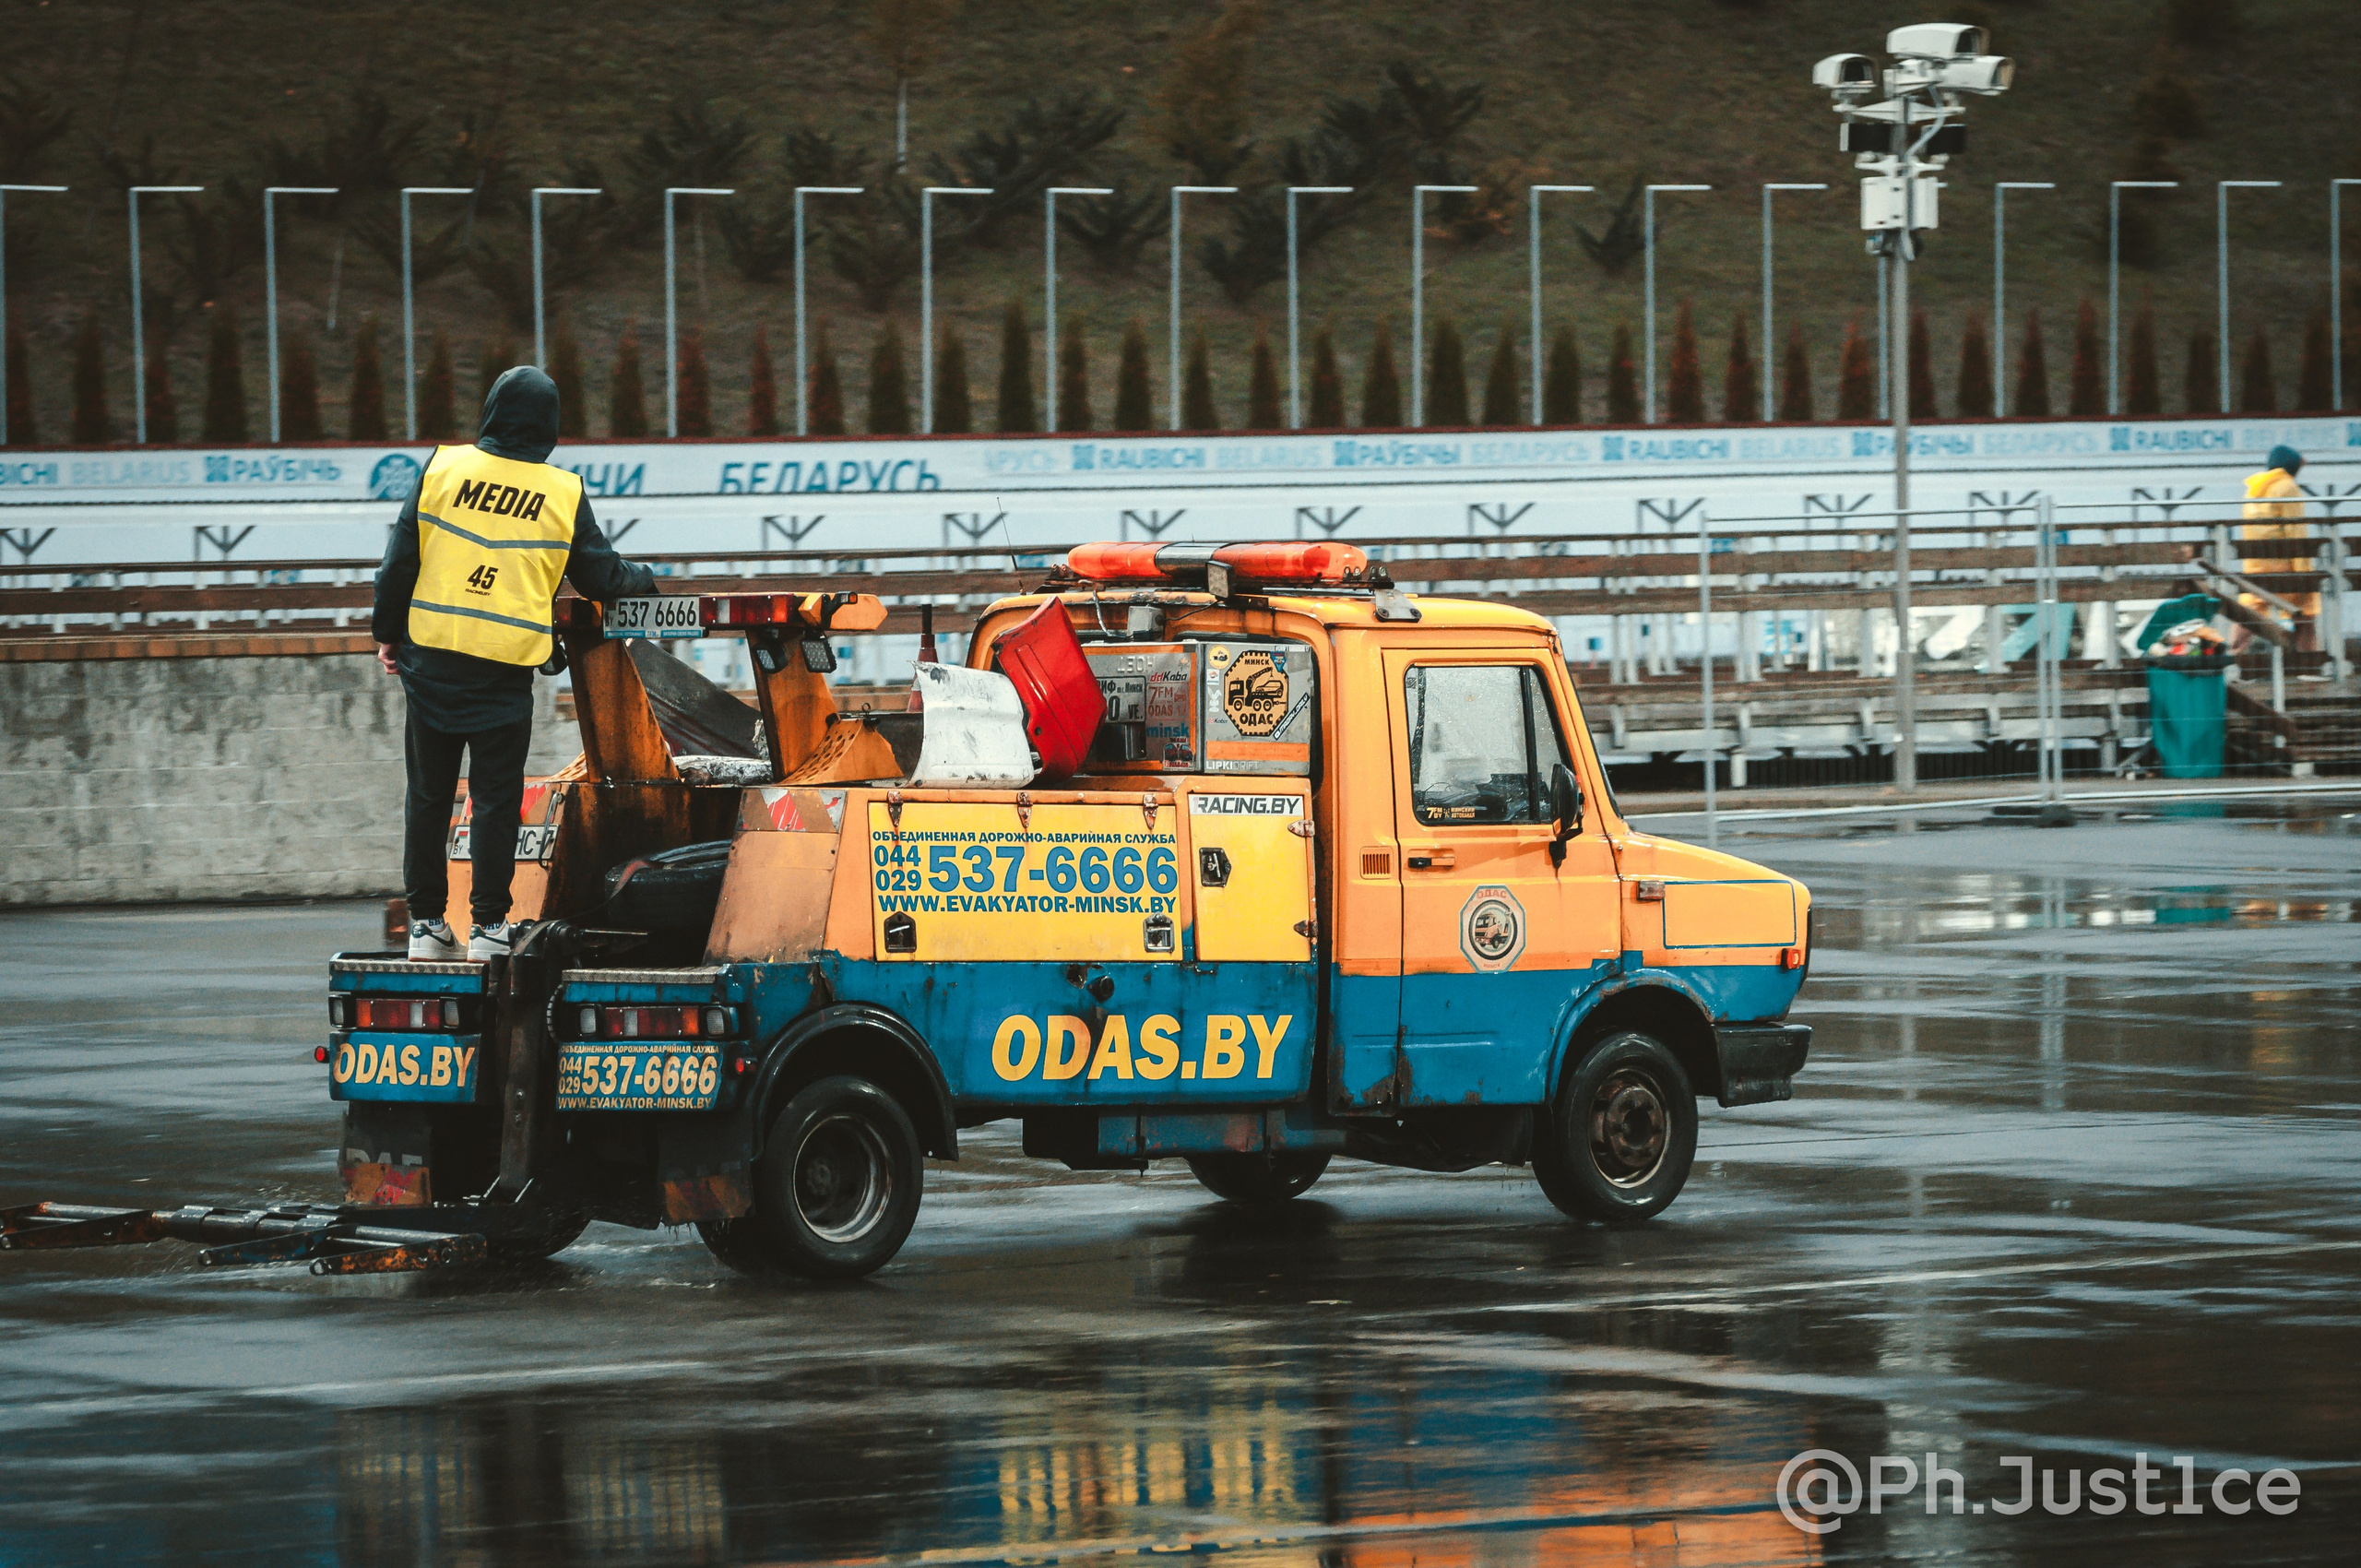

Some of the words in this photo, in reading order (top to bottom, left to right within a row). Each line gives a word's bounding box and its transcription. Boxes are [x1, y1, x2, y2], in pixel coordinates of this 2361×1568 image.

[1628, 439, 1730, 460] RAUBICHI
[2134, 428, 2233, 450] RAUBICHI
[1099, 447, 1206, 469] RAUBICHI
[718, 459, 941, 494] БЕЛАРУСЬ
[452, 479, 546, 521] MEDIA
[467, 564, 498, 589] 45
[618, 600, 650, 627] 537
[655, 600, 696, 627] 6666
[1146, 722, 1190, 738] minsk
[1240, 713, 1274, 726] ОДАС
[872, 831, 976, 844] ОБЪЕДИНЕННАЯ
[979, 831, 1121, 844] ДОРОЖНО-АВАРИЙНАЯ
[1124, 833, 1176, 844] СЛУЖБА
[453, 844, 464, 855] BY
[874, 845, 921, 867] 044
[928, 846, 1178, 894] 537-6666
[874, 870, 922, 892] 029
[878, 896, 1176, 913] WWW.EVAKYATOR-MINSK.BY
[1476, 888, 1507, 899] ОДАС
[561, 1045, 612, 1054] ОБЪЕДИНЕННАЯ
[614, 1044, 691, 1054] ДОРОЖНО-АВАРИЙНАЯ
[693, 1045, 719, 1054] СЛУЖБА
[991, 1014, 1293, 1081] ODAS.BY
[333, 1043, 475, 1088] ODAS.BY
[559, 1056, 582, 1075] 044
[581, 1055, 718, 1096] 537-6666
[559, 1075, 581, 1095] 029
[559, 1097, 712, 1110] WWW.EVAKYATOR-MINSK.BY
